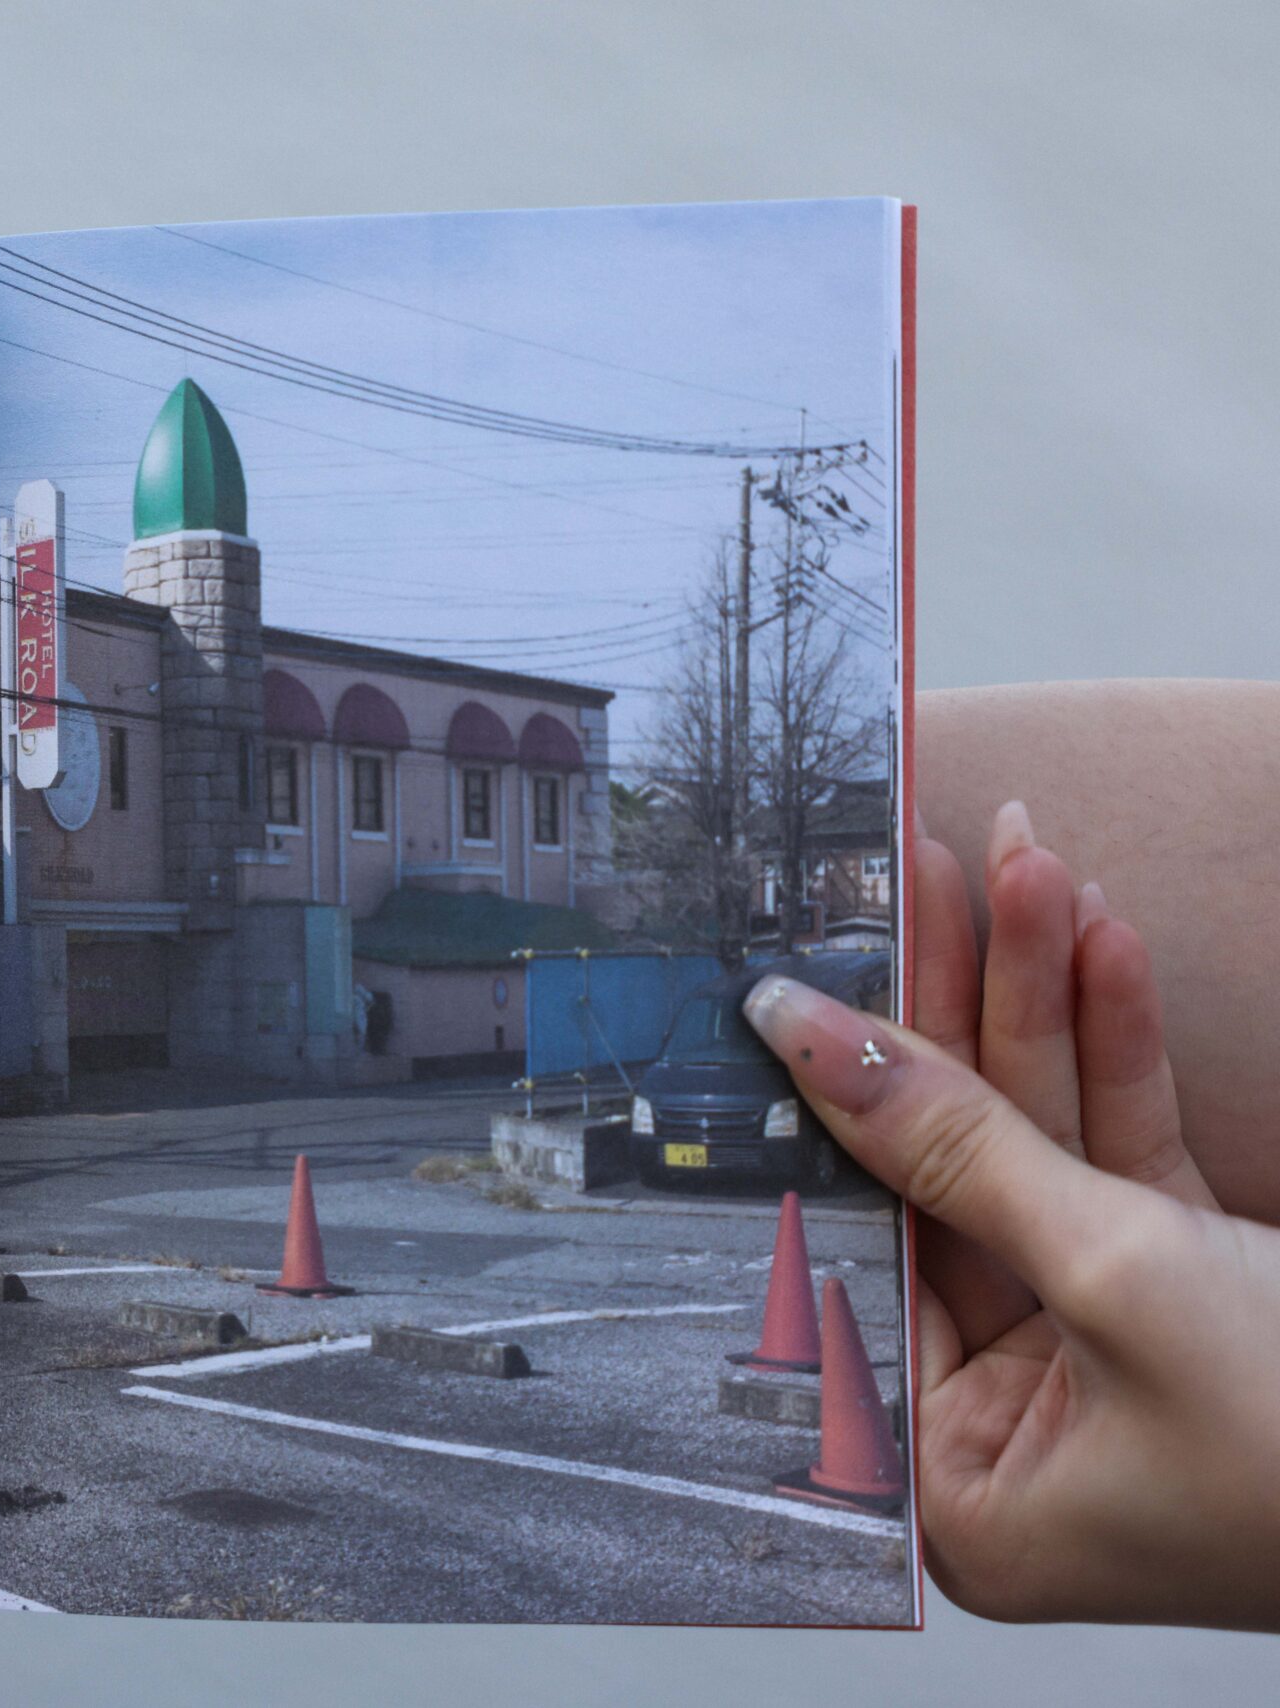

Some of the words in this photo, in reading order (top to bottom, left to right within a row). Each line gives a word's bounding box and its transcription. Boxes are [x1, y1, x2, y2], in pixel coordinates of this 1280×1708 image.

[19, 518, 37, 620] SILK
[41, 589, 53, 679] HOTEL
[20, 638, 38, 756] ROAD
